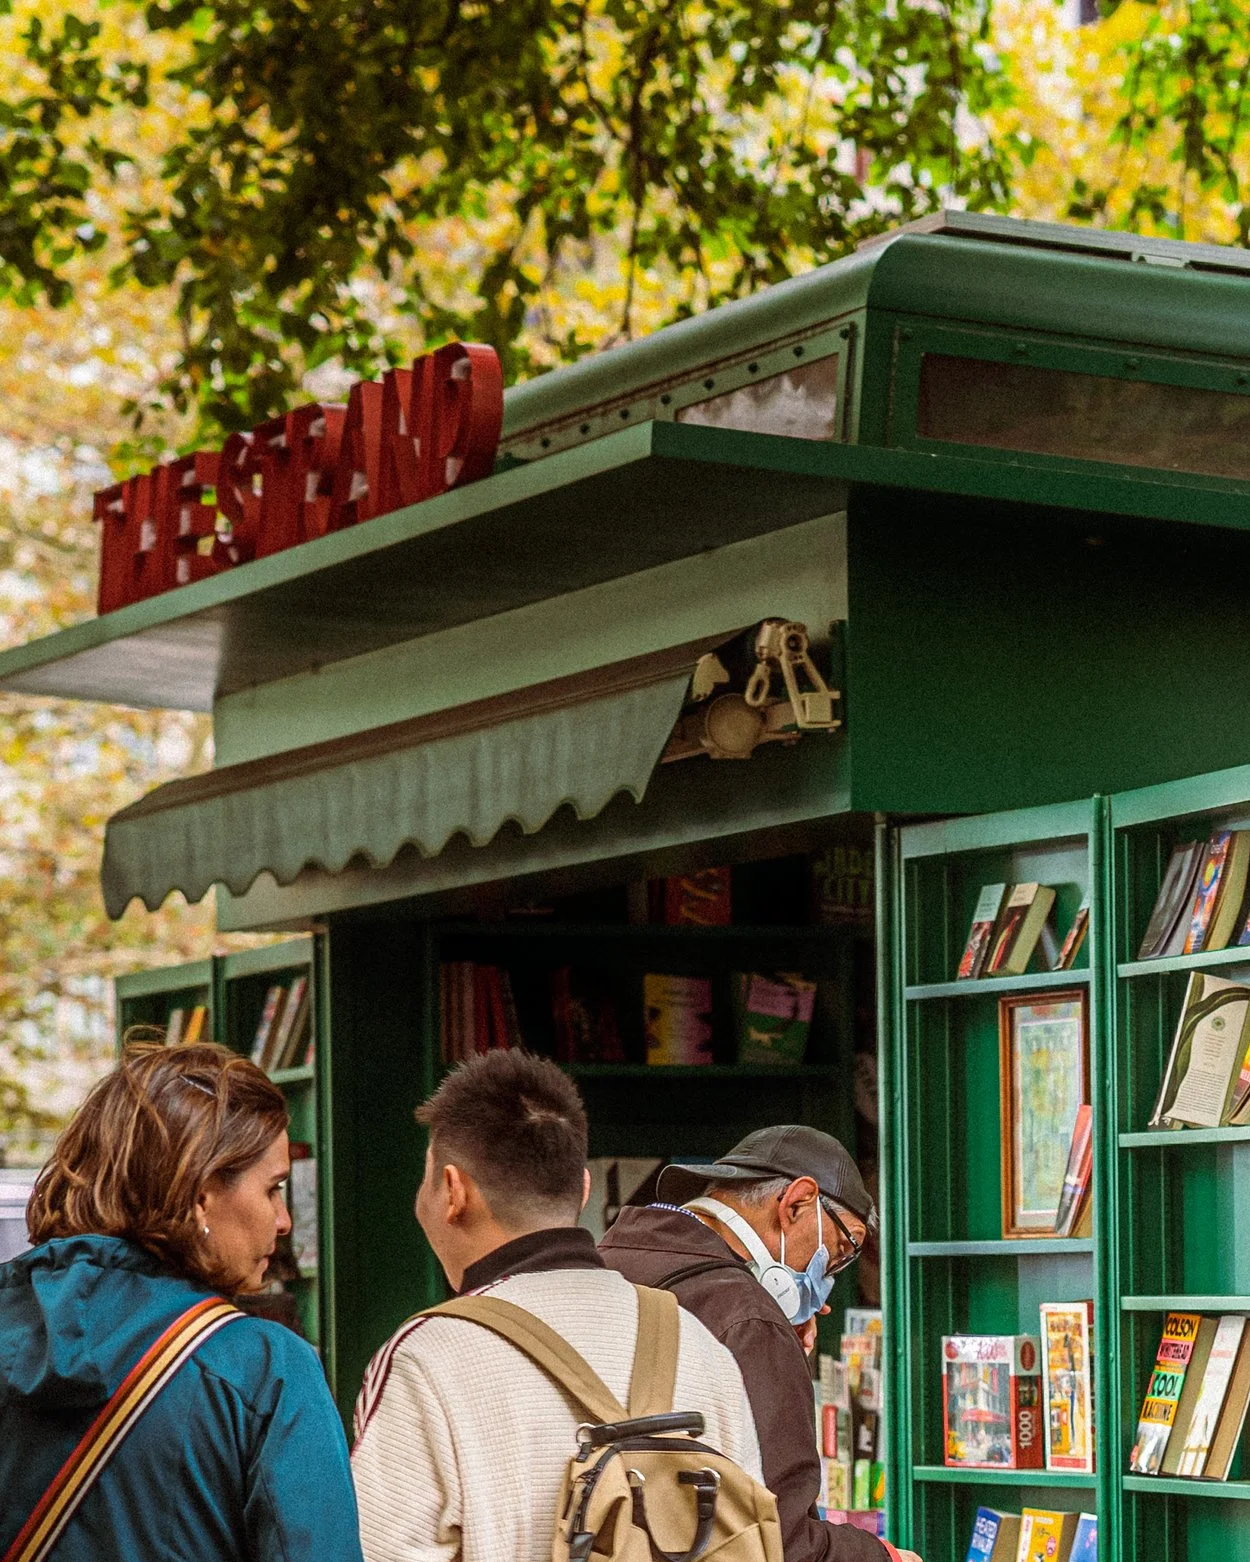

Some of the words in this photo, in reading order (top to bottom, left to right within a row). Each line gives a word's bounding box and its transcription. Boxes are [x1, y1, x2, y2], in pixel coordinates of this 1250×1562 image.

[212, 341, 504, 569] STRAND
[1165, 1317, 1197, 1337] COLSON
[1018, 1410, 1033, 1448] 1000
